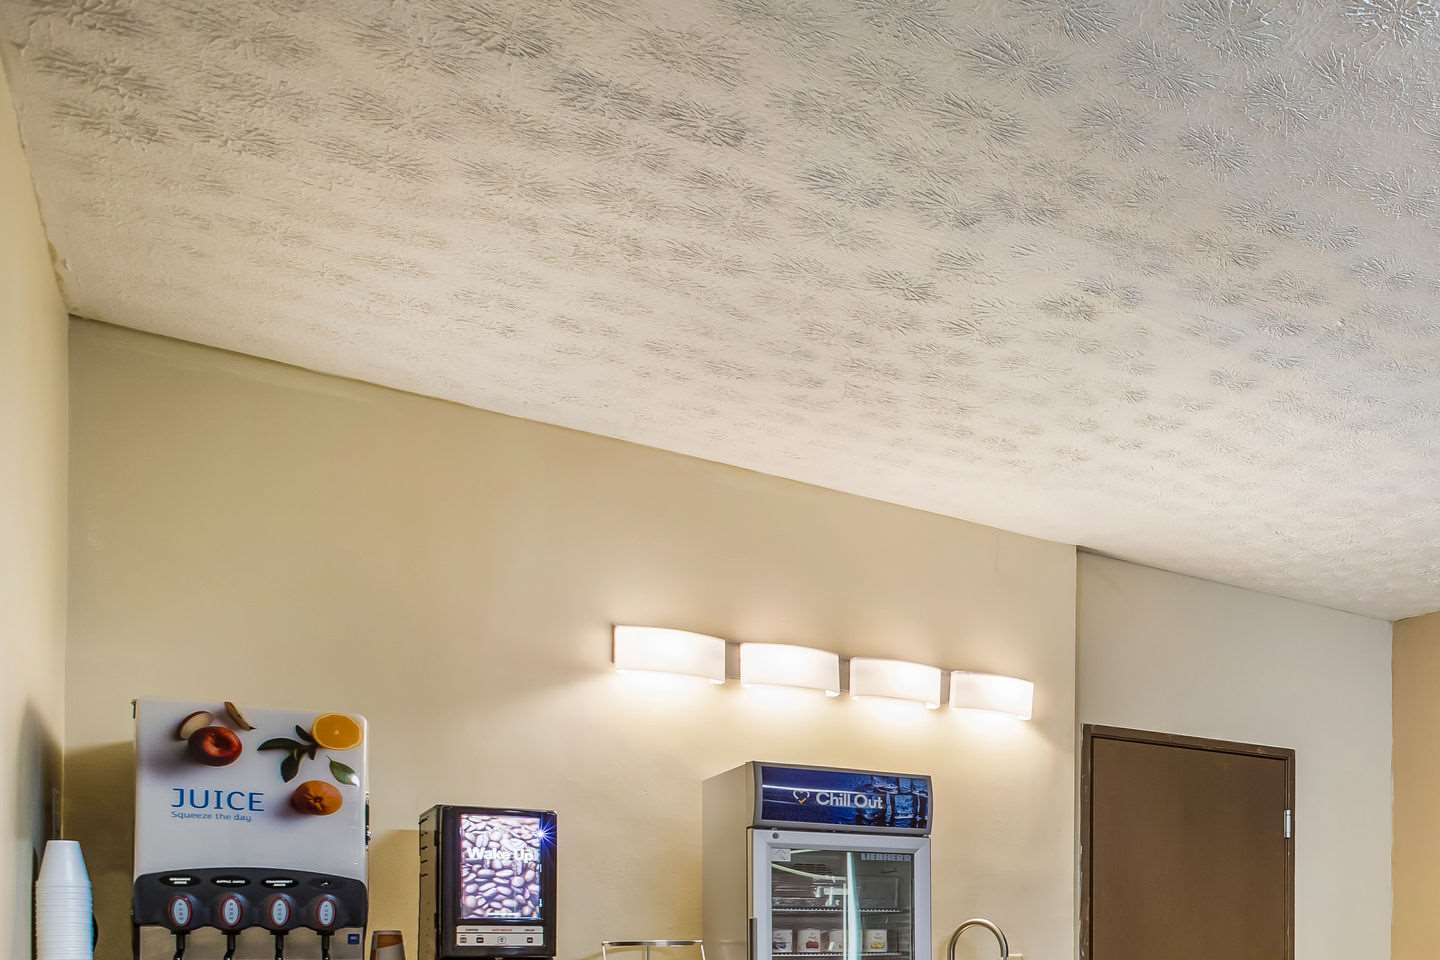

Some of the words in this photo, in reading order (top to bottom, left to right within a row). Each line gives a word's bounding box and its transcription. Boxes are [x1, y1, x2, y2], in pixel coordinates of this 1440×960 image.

[171, 788, 264, 811] JUICE
[816, 792, 850, 807] Chill
[854, 794, 883, 808] Out
[171, 811, 212, 819] Squeeze
[233, 814, 251, 822] day
[467, 847, 511, 860] Wake
[515, 848, 534, 863] Up
